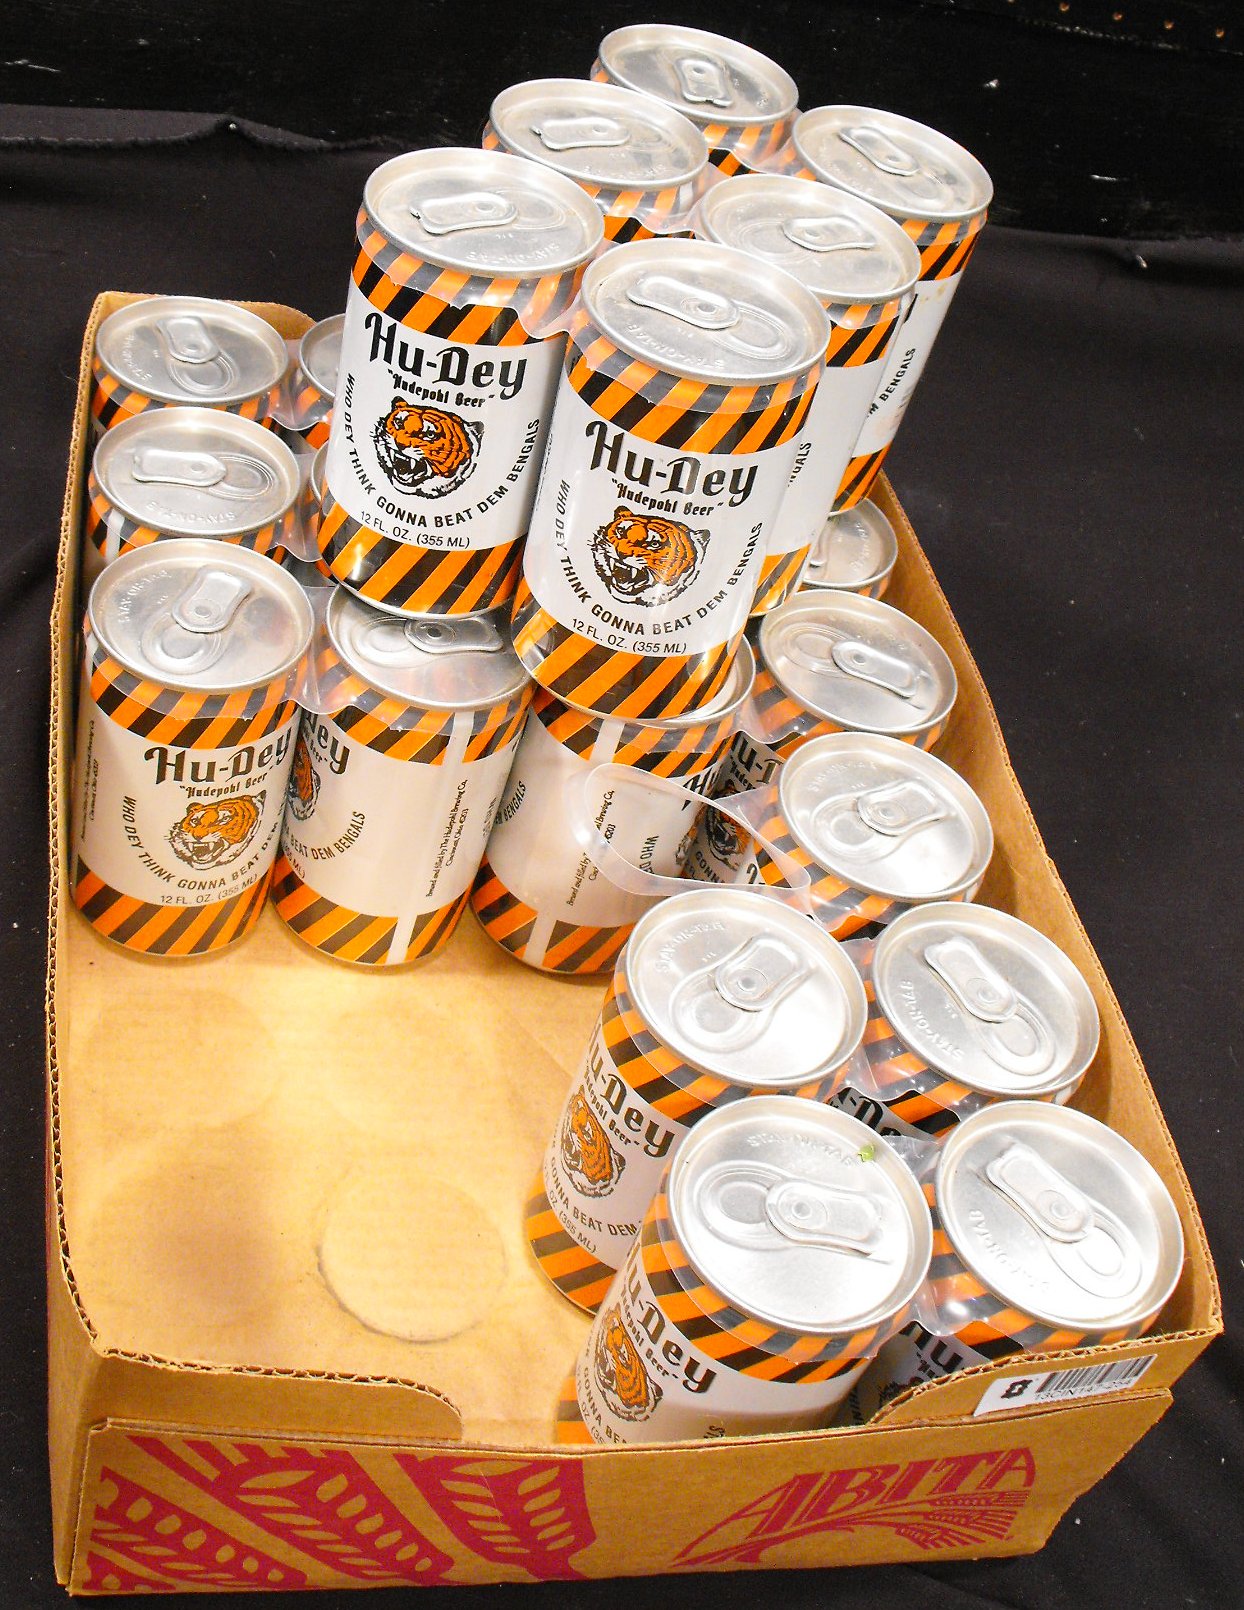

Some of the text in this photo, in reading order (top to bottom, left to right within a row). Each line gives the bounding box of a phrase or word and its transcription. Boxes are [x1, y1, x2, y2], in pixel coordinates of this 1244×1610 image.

[365, 312, 527, 401] Hu-Dey
[878, 347, 917, 402] BENGALS
[344, 372, 356, 409] WHO
[344, 416, 355, 444] DEY
[505, 418, 540, 483] BENGALS
[585, 419, 759, 508] Hu-Dey
[348, 450, 377, 496] THINK
[376, 496, 428, 528] GONNA
[476, 484, 509, 514] DEM
[361, 510, 471, 550] 12 FL. OZ. (355 ML)
[434, 508, 473, 529] BEAT
[554, 479, 763, 636] WHO DEY THINK GONNA BEAT DEM BENGALS
[571, 618, 687, 654] 12 FL. OZ. (355 ML)
[143, 726, 293, 785] Hu-Dey
[122, 795, 137, 822] WHO
[503, 780, 527, 821] BENGALS
[124, 825, 144, 849] DEY
[290, 836, 308, 859] BEAT
[311, 845, 336, 860] DEM
[334, 811, 366, 854] BENGALS
[640, 835, 660, 861] WHO
[138, 851, 176, 883] THINK
[177, 876, 227, 891] GONNA
[231, 856, 260, 880] BEAT
[160, 894, 173, 905] 12
[175, 894, 191, 905] FL.
[195, 892, 214, 904] OZ.
[218, 883, 241, 900] (355
[550, 1156, 570, 1209] GONNA
[572, 1206, 603, 1233] BEAT
[607, 1223, 638, 1237] DEM
[577, 1231, 598, 1254] ML)
[583, 1367, 602, 1426] GONNA
[673, 1447, 1036, 1562] ABITA
